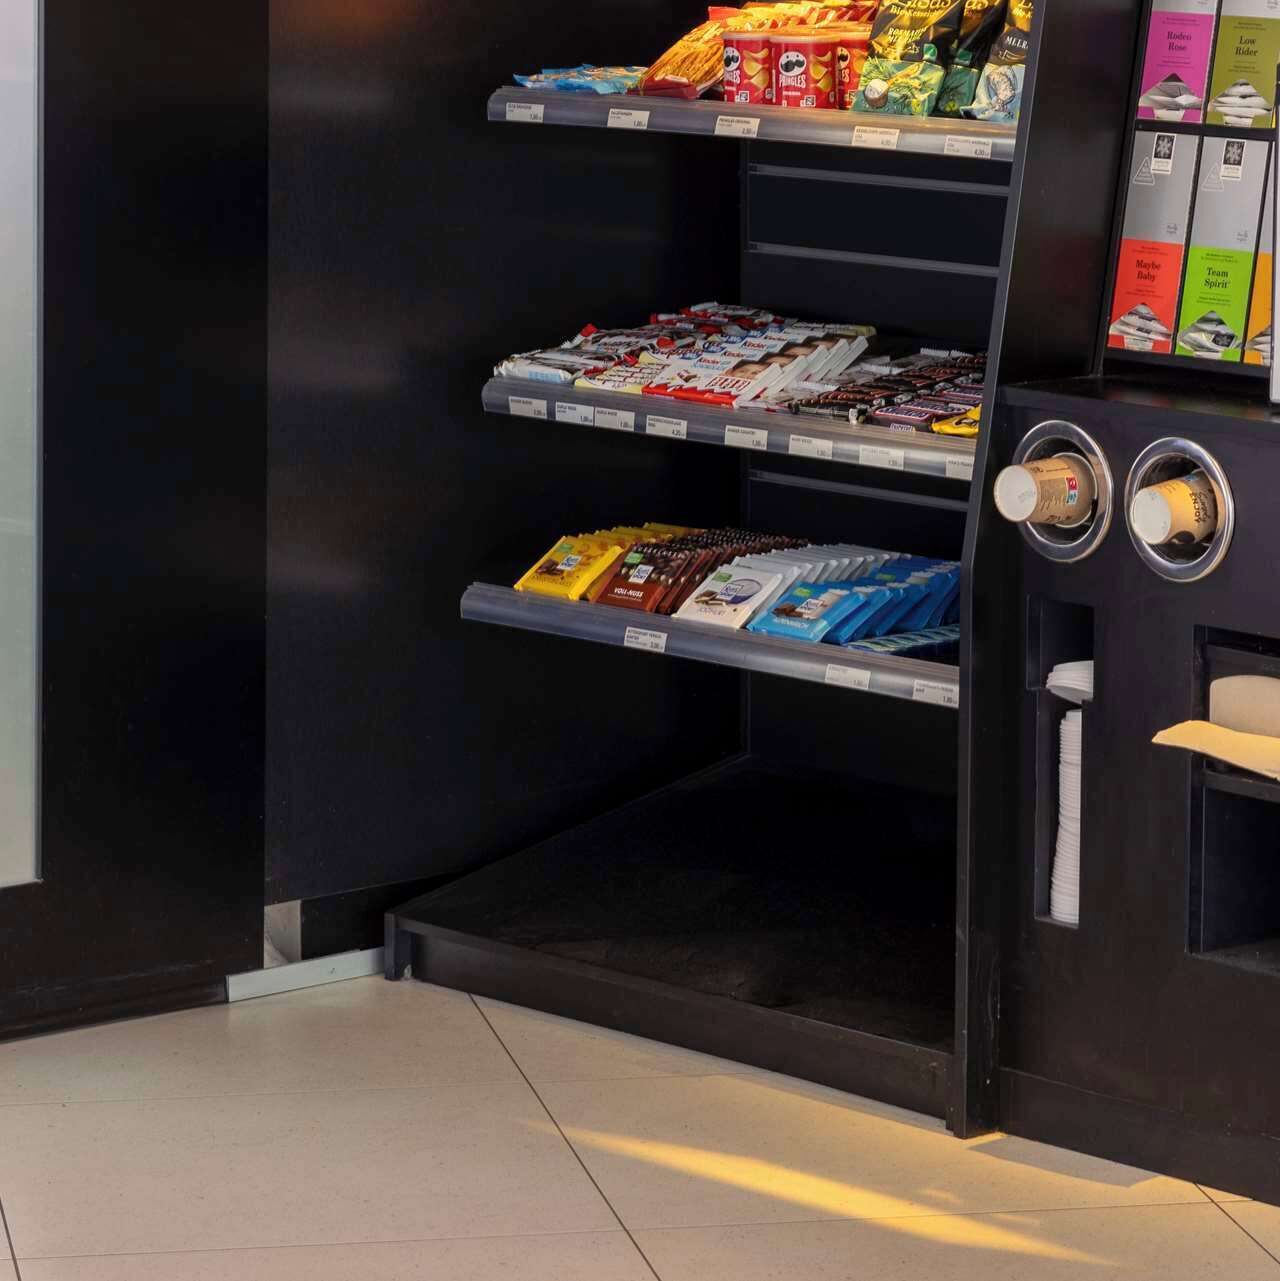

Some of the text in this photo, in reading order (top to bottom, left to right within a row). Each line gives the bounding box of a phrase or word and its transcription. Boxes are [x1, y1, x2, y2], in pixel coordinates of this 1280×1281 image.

[1239, 35, 1257, 45] Low
[1235, 46, 1259, 57] Rider
[1135, 259, 1161, 272] Maybe
[1206, 267, 1229, 278] Team
